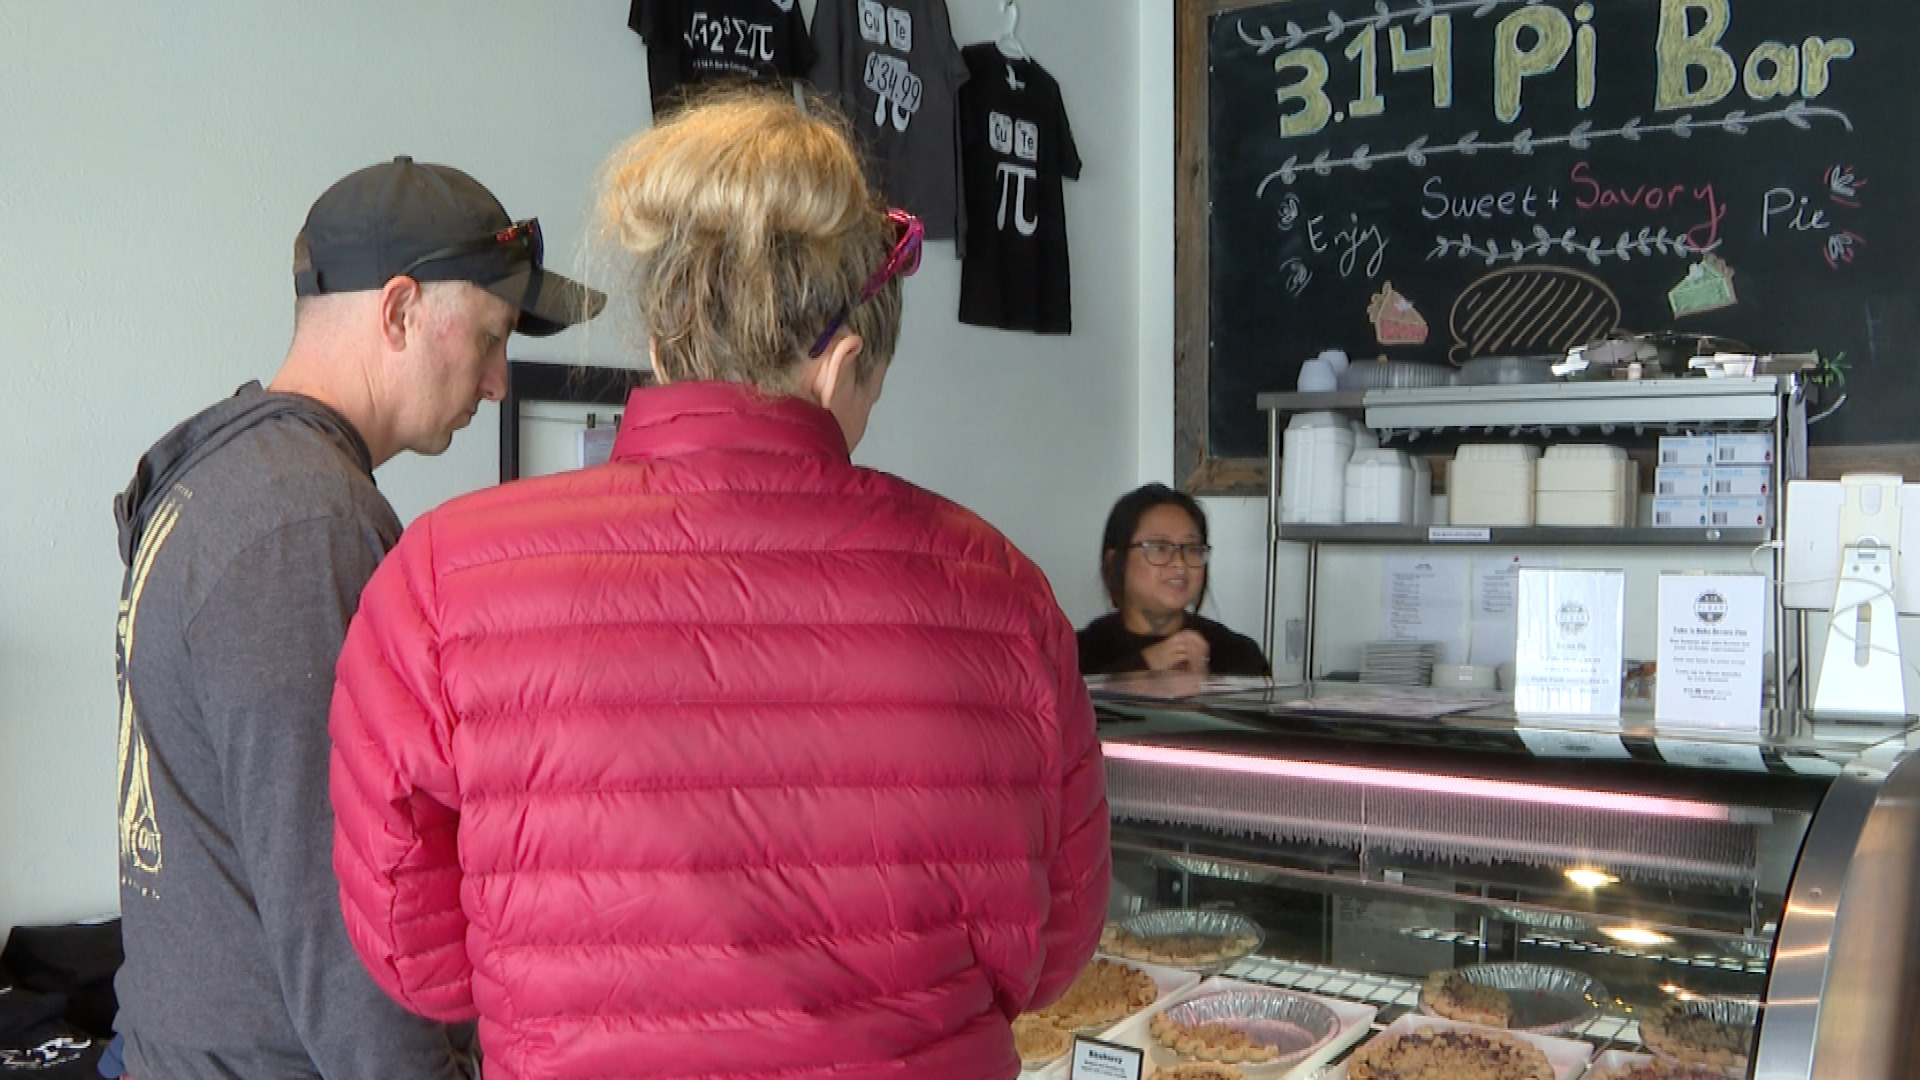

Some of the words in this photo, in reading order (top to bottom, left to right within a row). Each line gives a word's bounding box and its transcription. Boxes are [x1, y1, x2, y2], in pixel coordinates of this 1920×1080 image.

[894, 19, 907, 41] Te
[866, 52, 920, 110] $34.99
[1275, 14, 1454, 138] 3.14
[1494, 2, 1598, 123] Pi
[1654, 0, 1855, 111] Bar
[1421, 176, 1537, 219] Sweet
[1571, 161, 1727, 251] Savory
[1762, 187, 1830, 236] Pie
